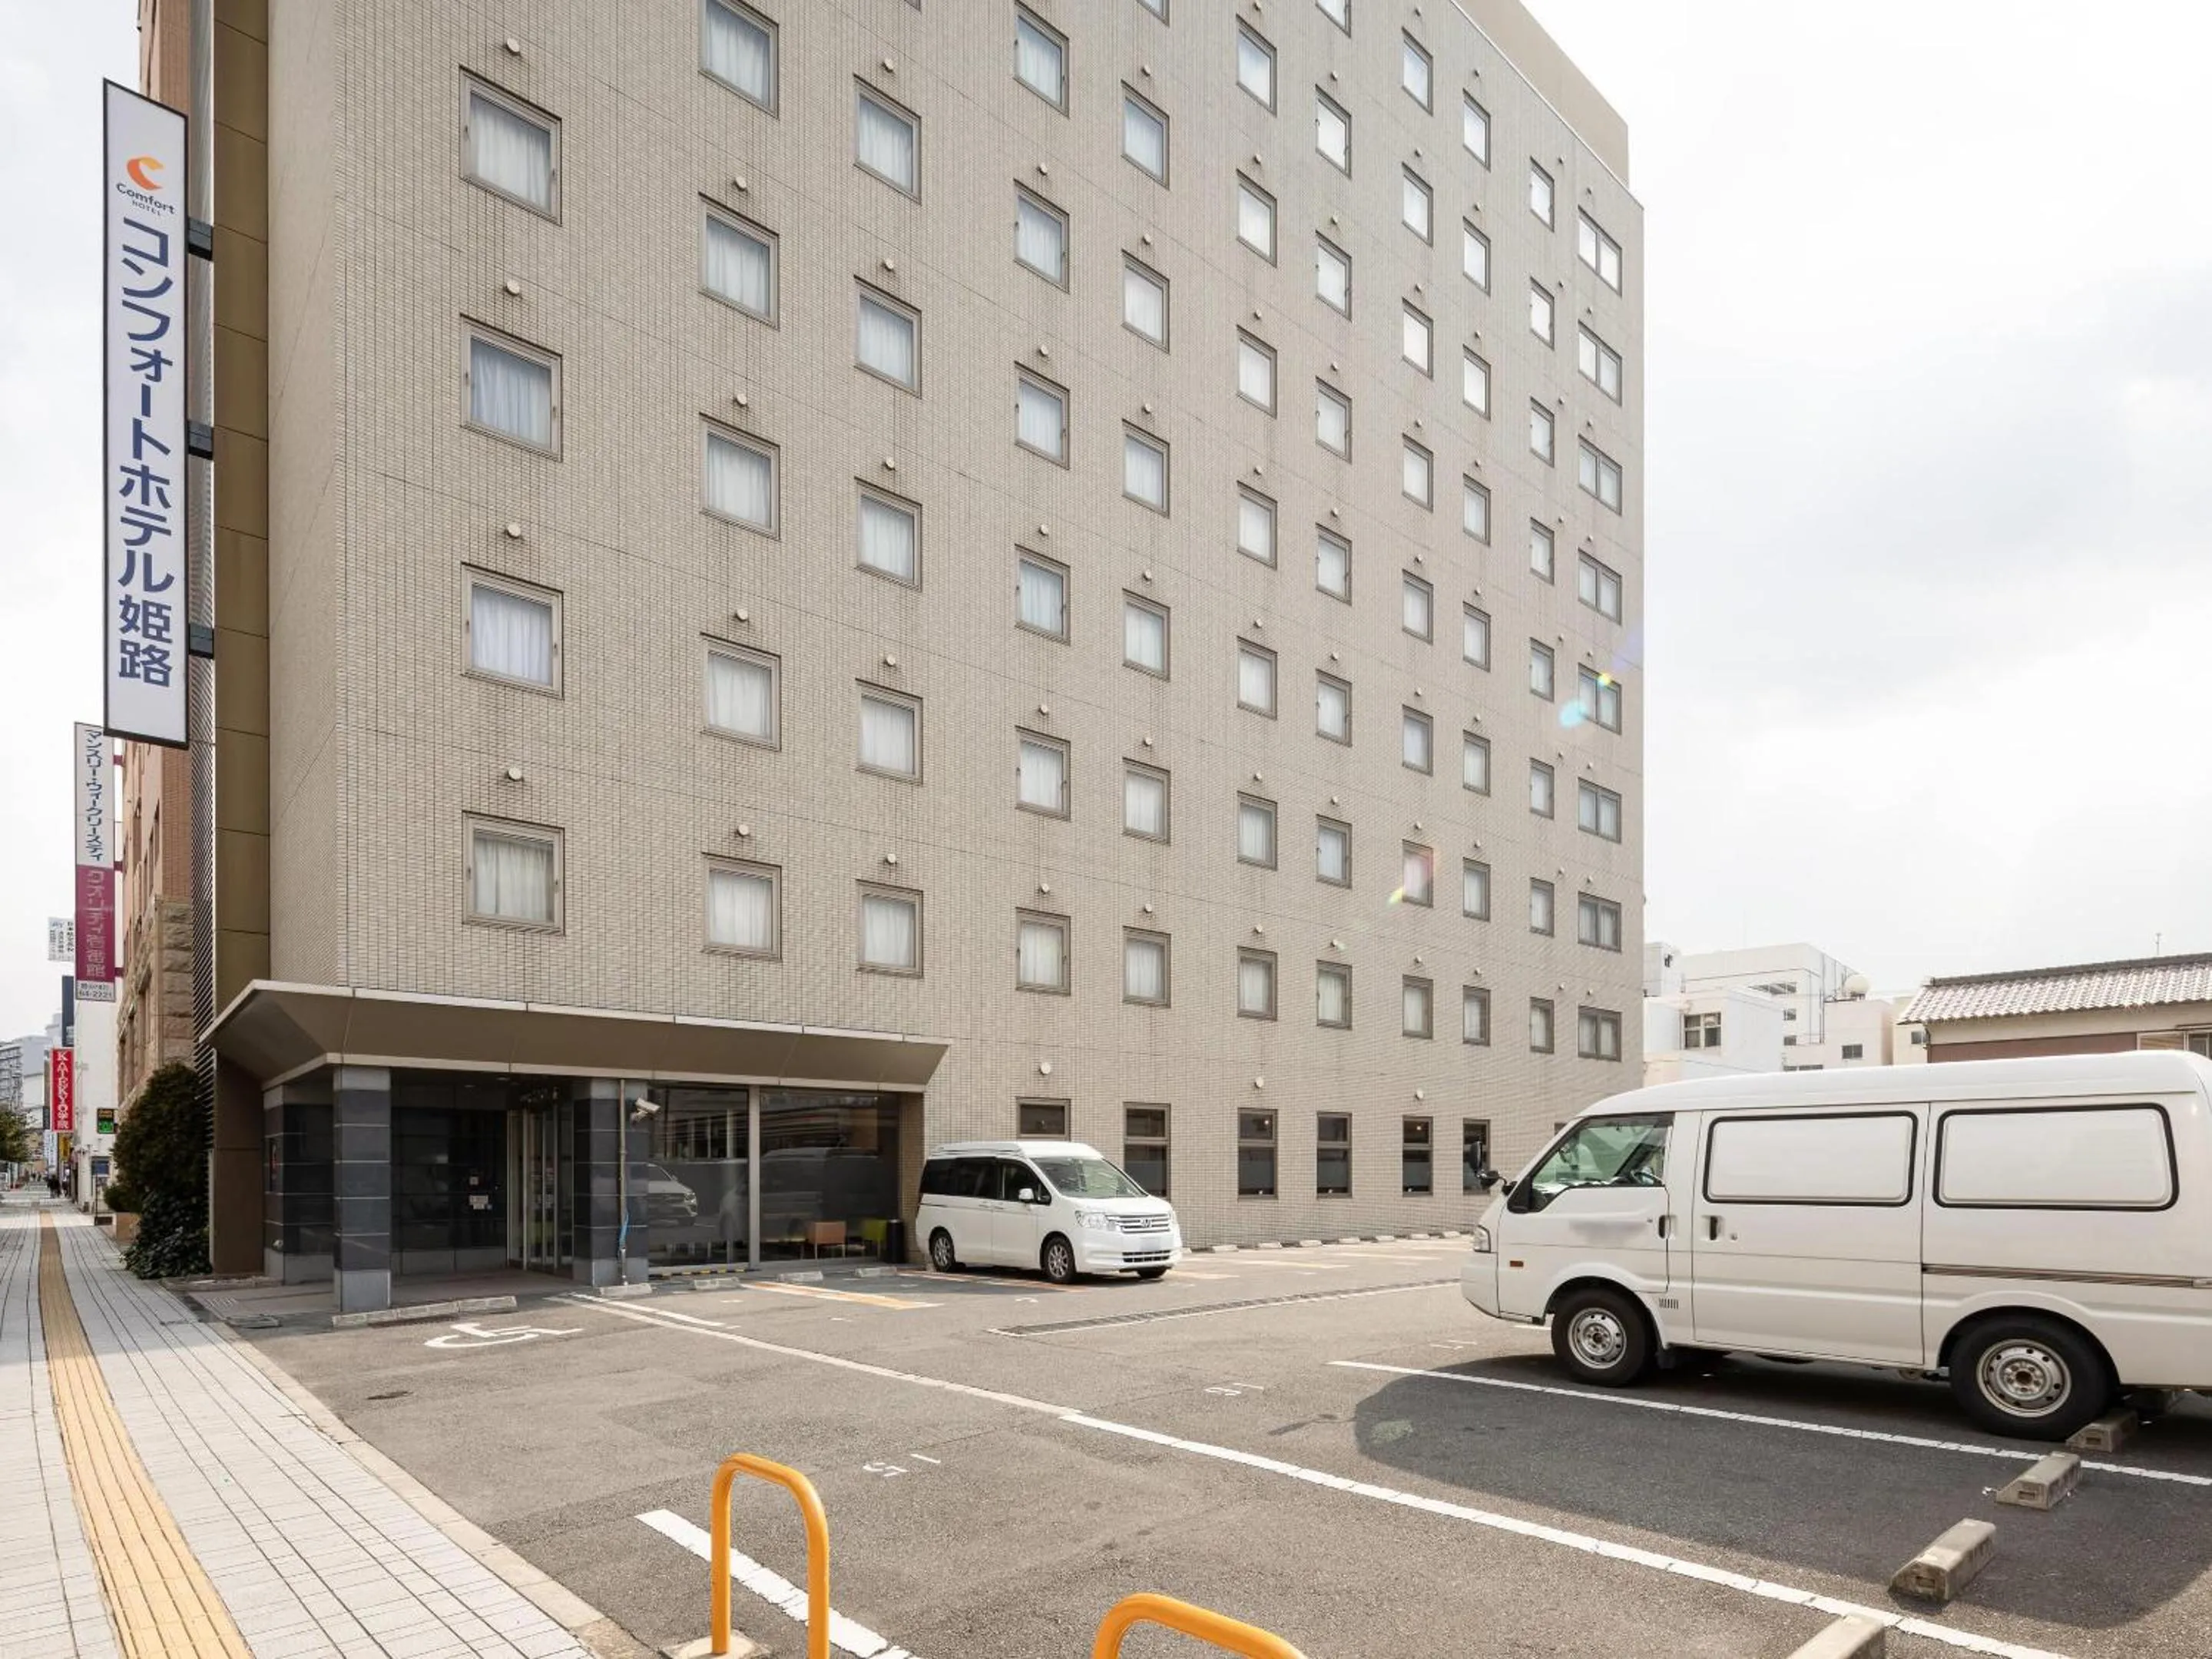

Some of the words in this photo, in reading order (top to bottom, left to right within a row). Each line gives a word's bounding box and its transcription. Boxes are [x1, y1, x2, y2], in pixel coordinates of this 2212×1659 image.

[117, 183, 175, 214] Comfort
[132, 200, 161, 216] HOTEL
[118, 217, 174, 687] コンフォートホテル姫路
